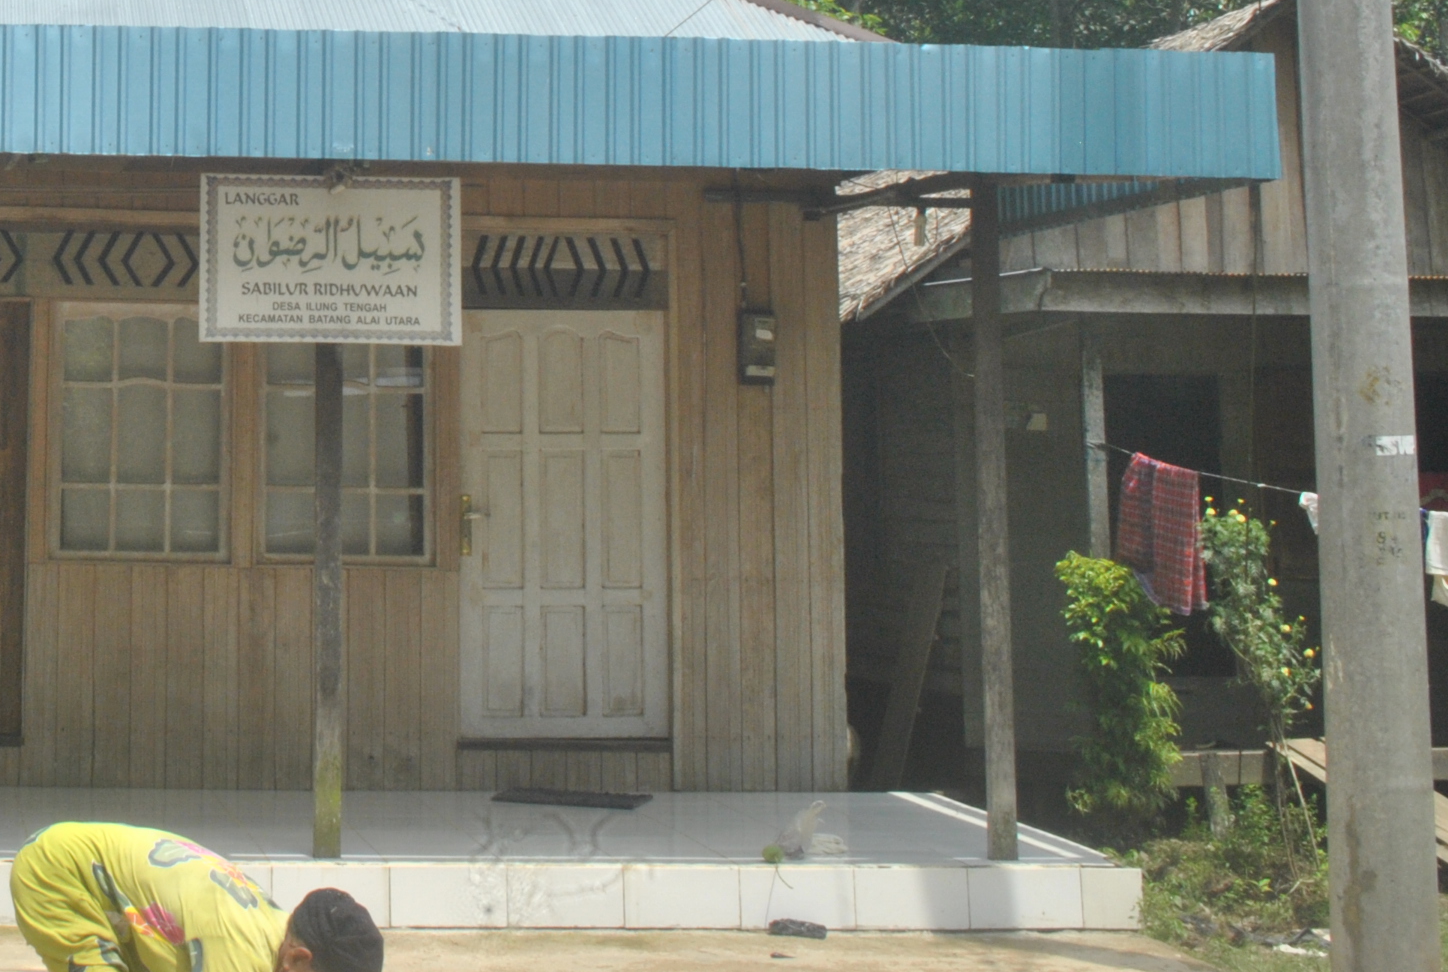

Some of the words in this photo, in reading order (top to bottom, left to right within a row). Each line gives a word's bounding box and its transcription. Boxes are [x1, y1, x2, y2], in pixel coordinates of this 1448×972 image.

[225, 191, 300, 206] LANGGAR
[241, 282, 308, 296] SABILUR
[314, 283, 418, 298] RIDHUWAAN
[272, 301, 301, 311] DESA
[306, 302, 338, 312] ILUNG
[344, 302, 387, 313] TENGAH
[238, 313, 303, 324] KECAMATAN
[308, 314, 351, 325] BATANG
[356, 315, 380, 325] ALAI
[385, 316, 421, 326] UTARA
